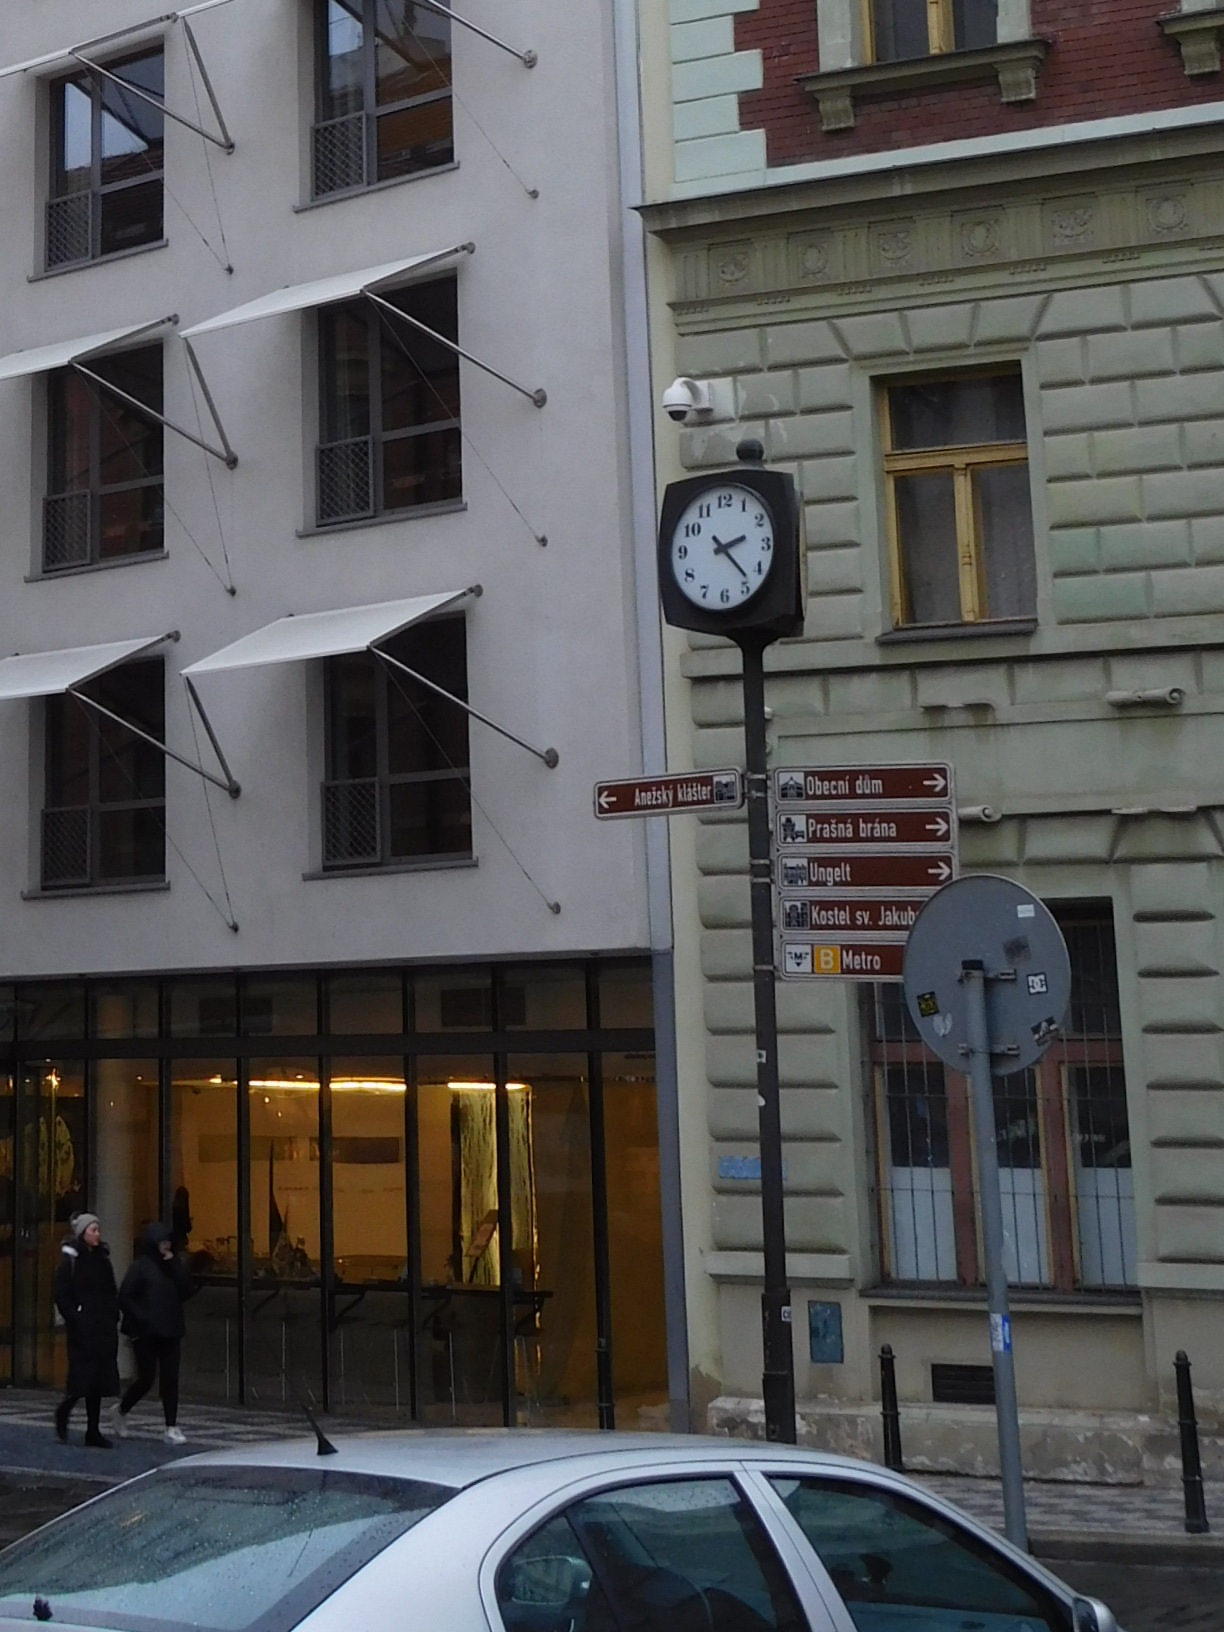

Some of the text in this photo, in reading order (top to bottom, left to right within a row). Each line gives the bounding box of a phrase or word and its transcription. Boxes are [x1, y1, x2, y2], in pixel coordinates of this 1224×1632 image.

[717, 493, 733, 509] 12
[741, 496, 746, 513] 1
[698, 503, 711, 519] 11
[754, 513, 764, 528] 2
[684, 522, 702, 538] 10
[761, 536, 771, 551] 3
[678, 545, 688, 560] 9
[684, 568, 695, 583] 8
[753, 560, 762, 576] 4
[700, 583, 709, 599] 7
[740, 579, 750, 596] 5
[720, 588, 730, 604] 6
[806, 775, 850, 795] Obecní
[634, 782, 712, 807] Anežský klášter
[808, 817, 897, 838] Prašná brána
[809, 862, 851, 886] Ungelt
[811, 905, 919, 926] Kostel sv. Jakub
[820, 949, 834, 970] B
[842, 949, 881, 970] Metro
